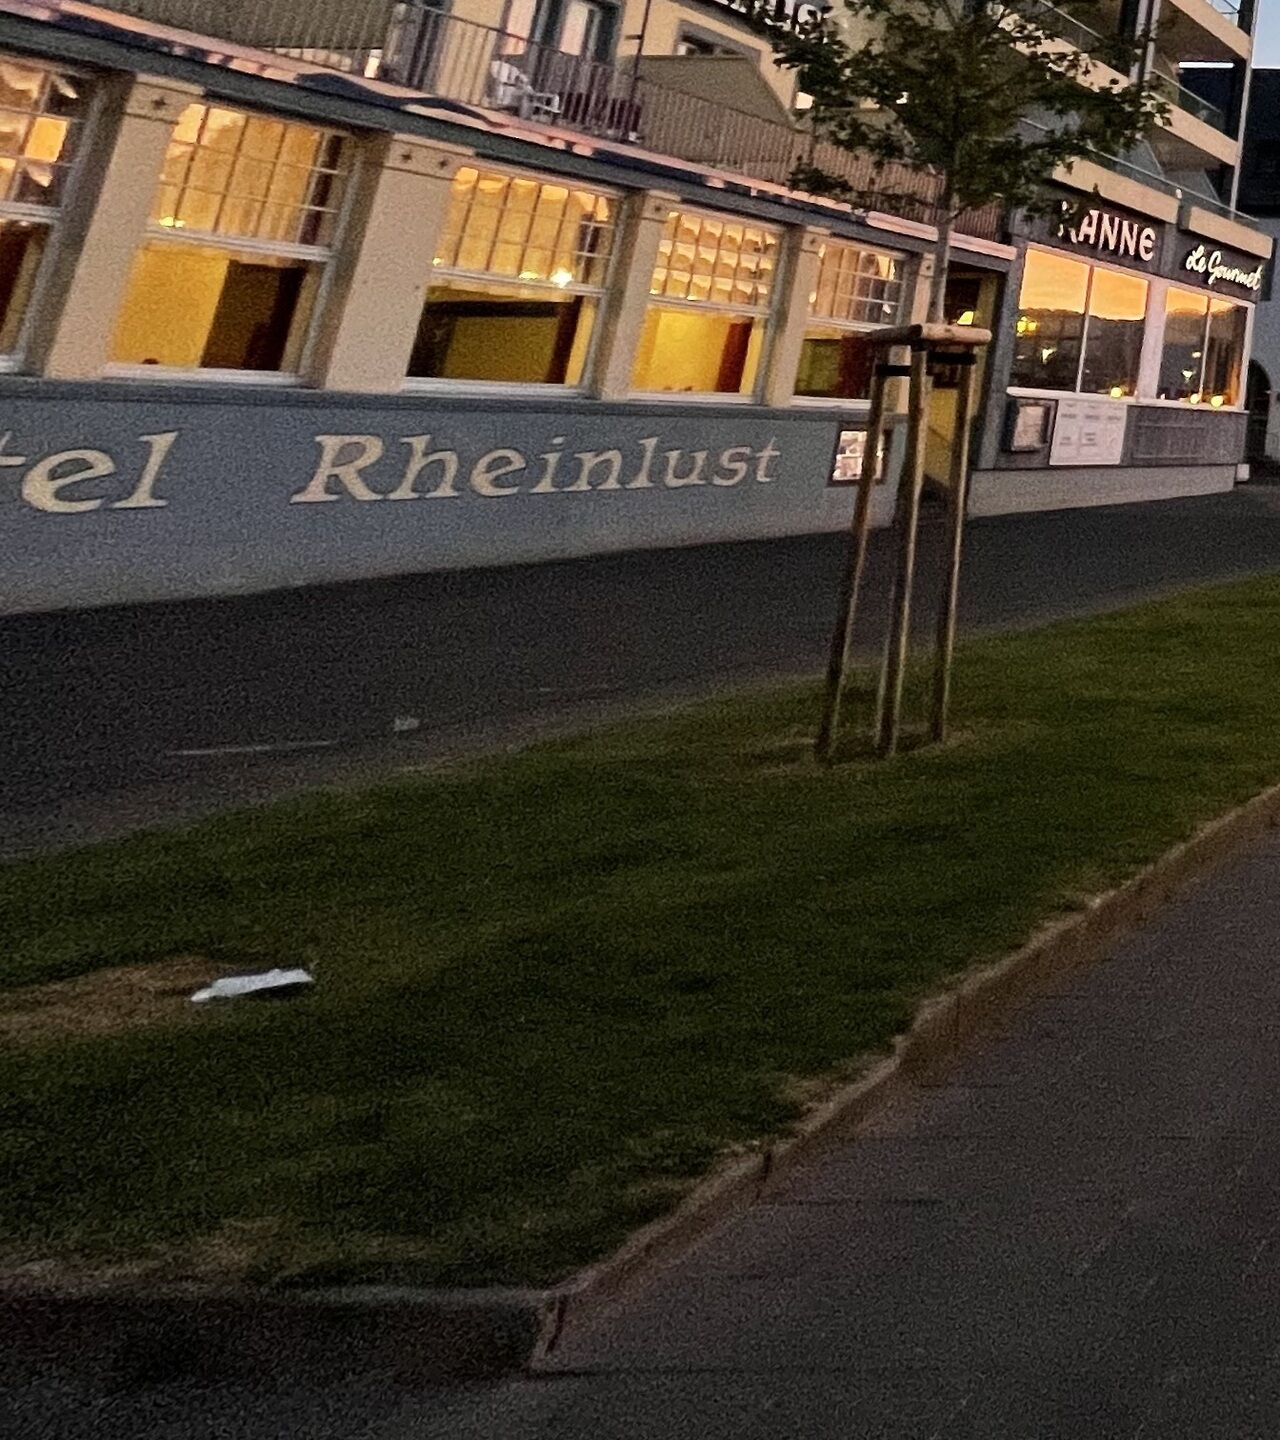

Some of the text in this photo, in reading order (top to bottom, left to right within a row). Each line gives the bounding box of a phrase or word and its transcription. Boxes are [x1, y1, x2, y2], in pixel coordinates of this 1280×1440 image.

[1185, 244, 1263, 291] Le Gourmet
[290, 433, 783, 504] Rheinlust
